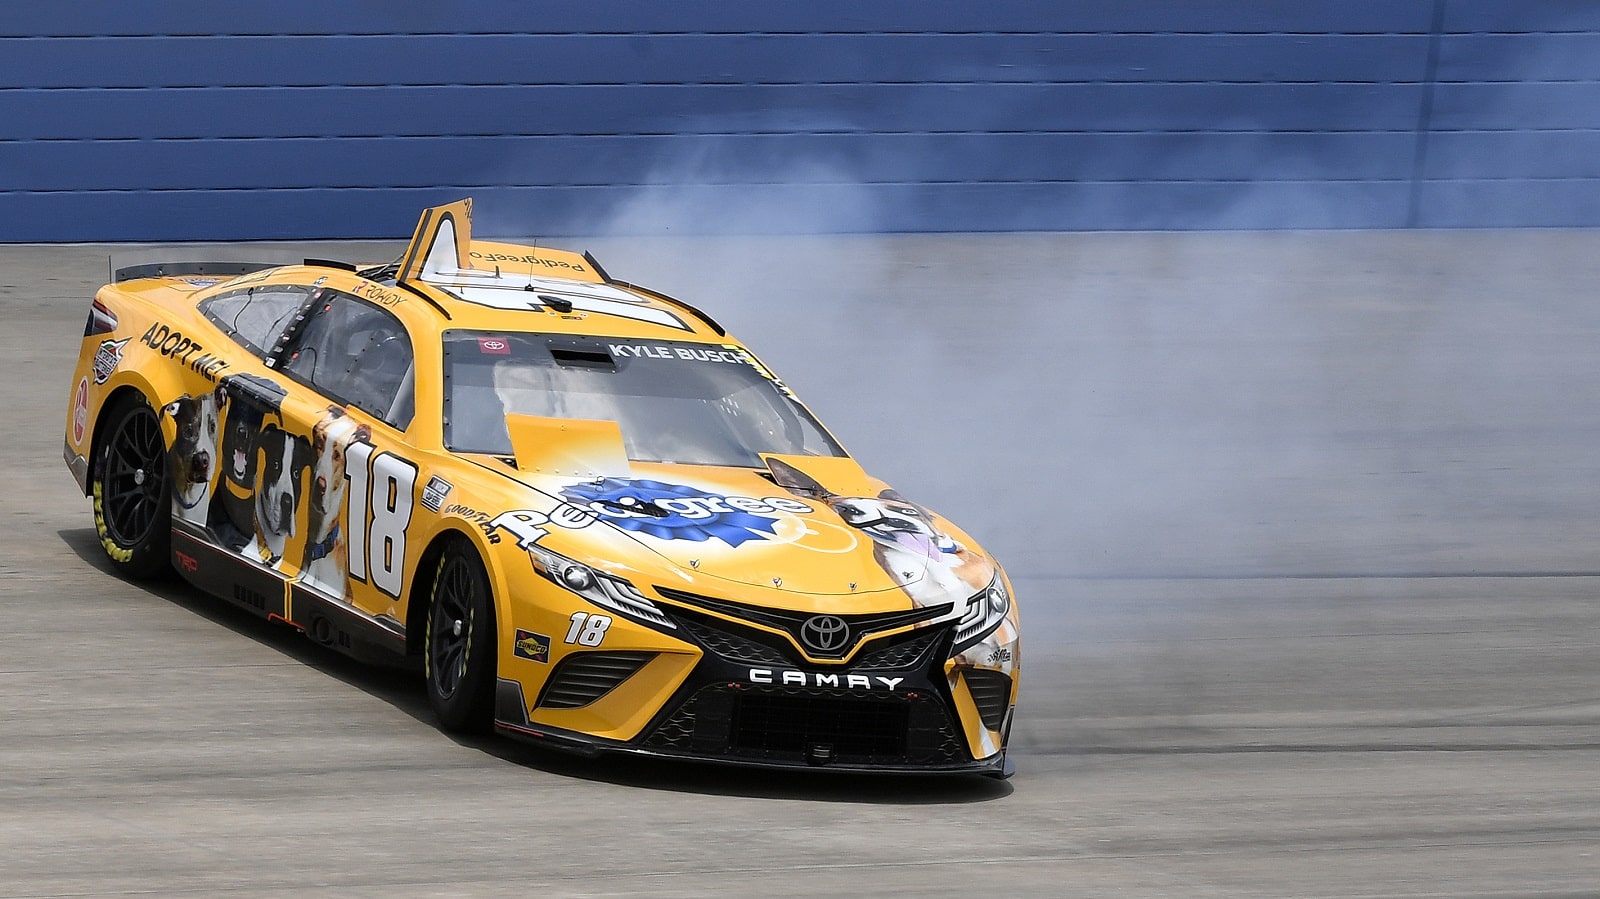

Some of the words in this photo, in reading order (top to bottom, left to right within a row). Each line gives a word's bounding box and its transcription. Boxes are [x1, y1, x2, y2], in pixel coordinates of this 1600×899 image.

[366, 284, 408, 308] ROWDY
[140, 321, 203, 366] ADOPT
[608, 344, 674, 359] KYLE
[673, 348, 750, 365] BUSCH
[344, 440, 420, 601] 18
[444, 503, 502, 545] GOODYEAR
[175, 549, 198, 572] TRD
[564, 610, 613, 648] 18
[517, 639, 547, 654] SUNOCO
[749, 668, 904, 691] CAMRY
